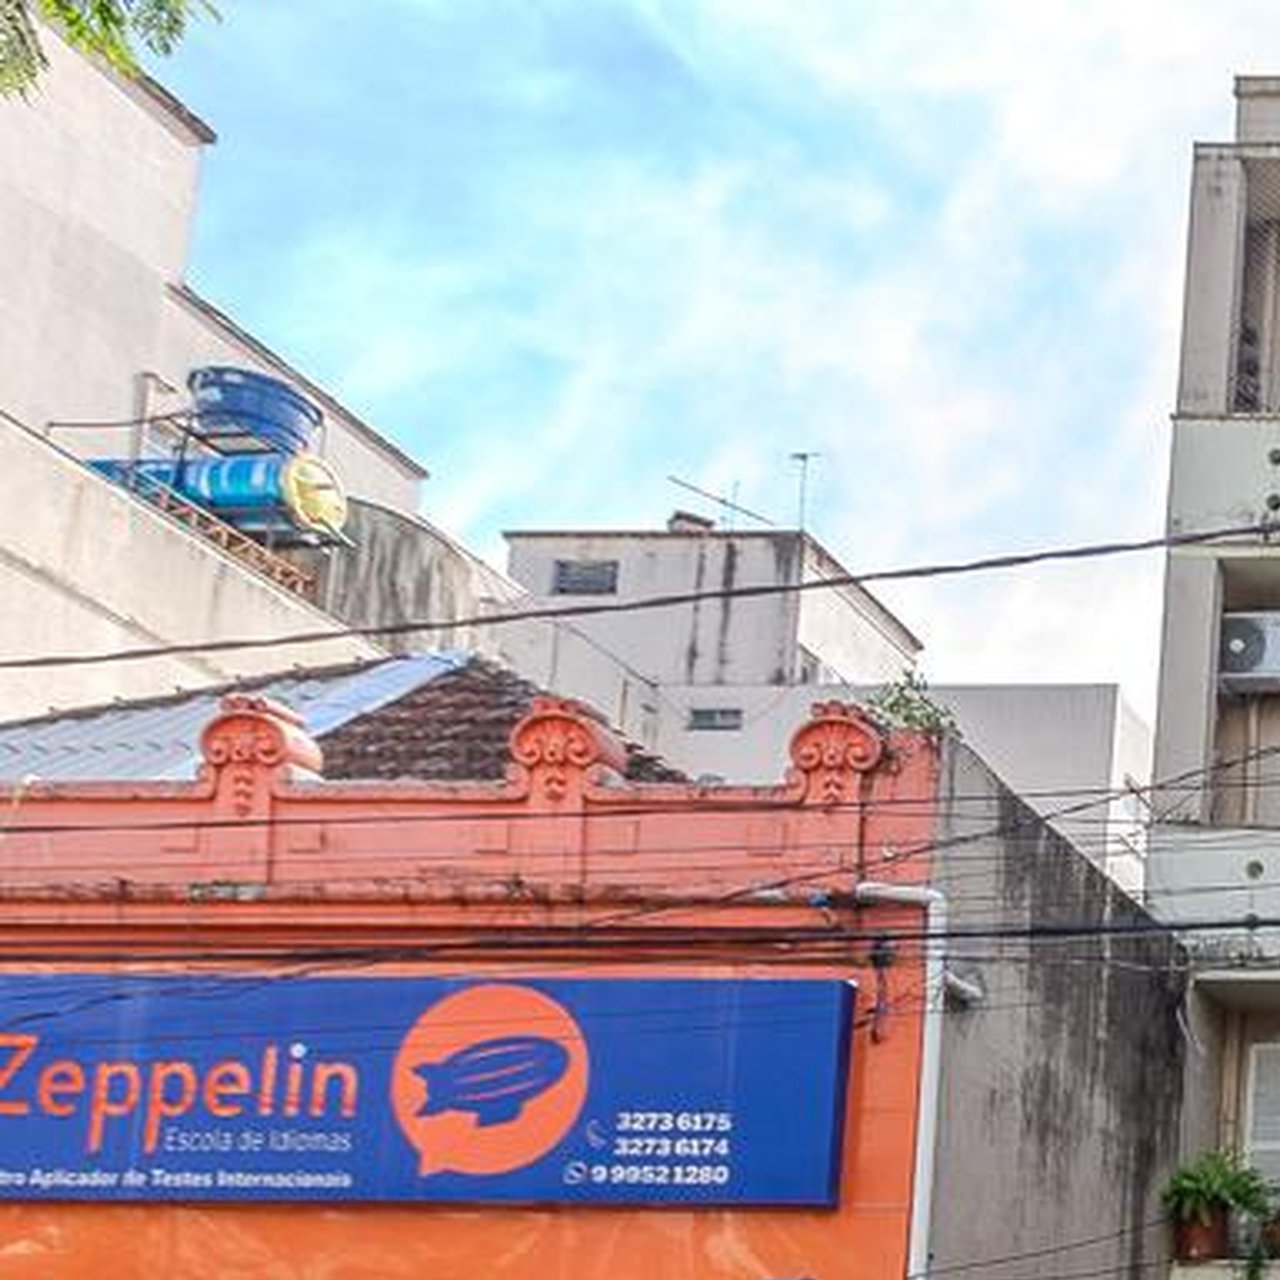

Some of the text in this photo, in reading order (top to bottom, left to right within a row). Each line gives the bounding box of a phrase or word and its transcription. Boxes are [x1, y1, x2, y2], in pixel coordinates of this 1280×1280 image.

[0, 1033, 358, 1154] Zeppelin
[616, 1112, 732, 1131] 3273 6175
[164, 1126, 352, 1151] Escola de Idiomas
[613, 1138, 729, 1156] 3273 6174
[29, 1168, 117, 1189] Aplicador
[121, 1169, 146, 1187] de
[150, 1168, 211, 1187] Testes
[217, 1169, 352, 1188] Internacionais
[673, 1165, 729, 1184] 1280
